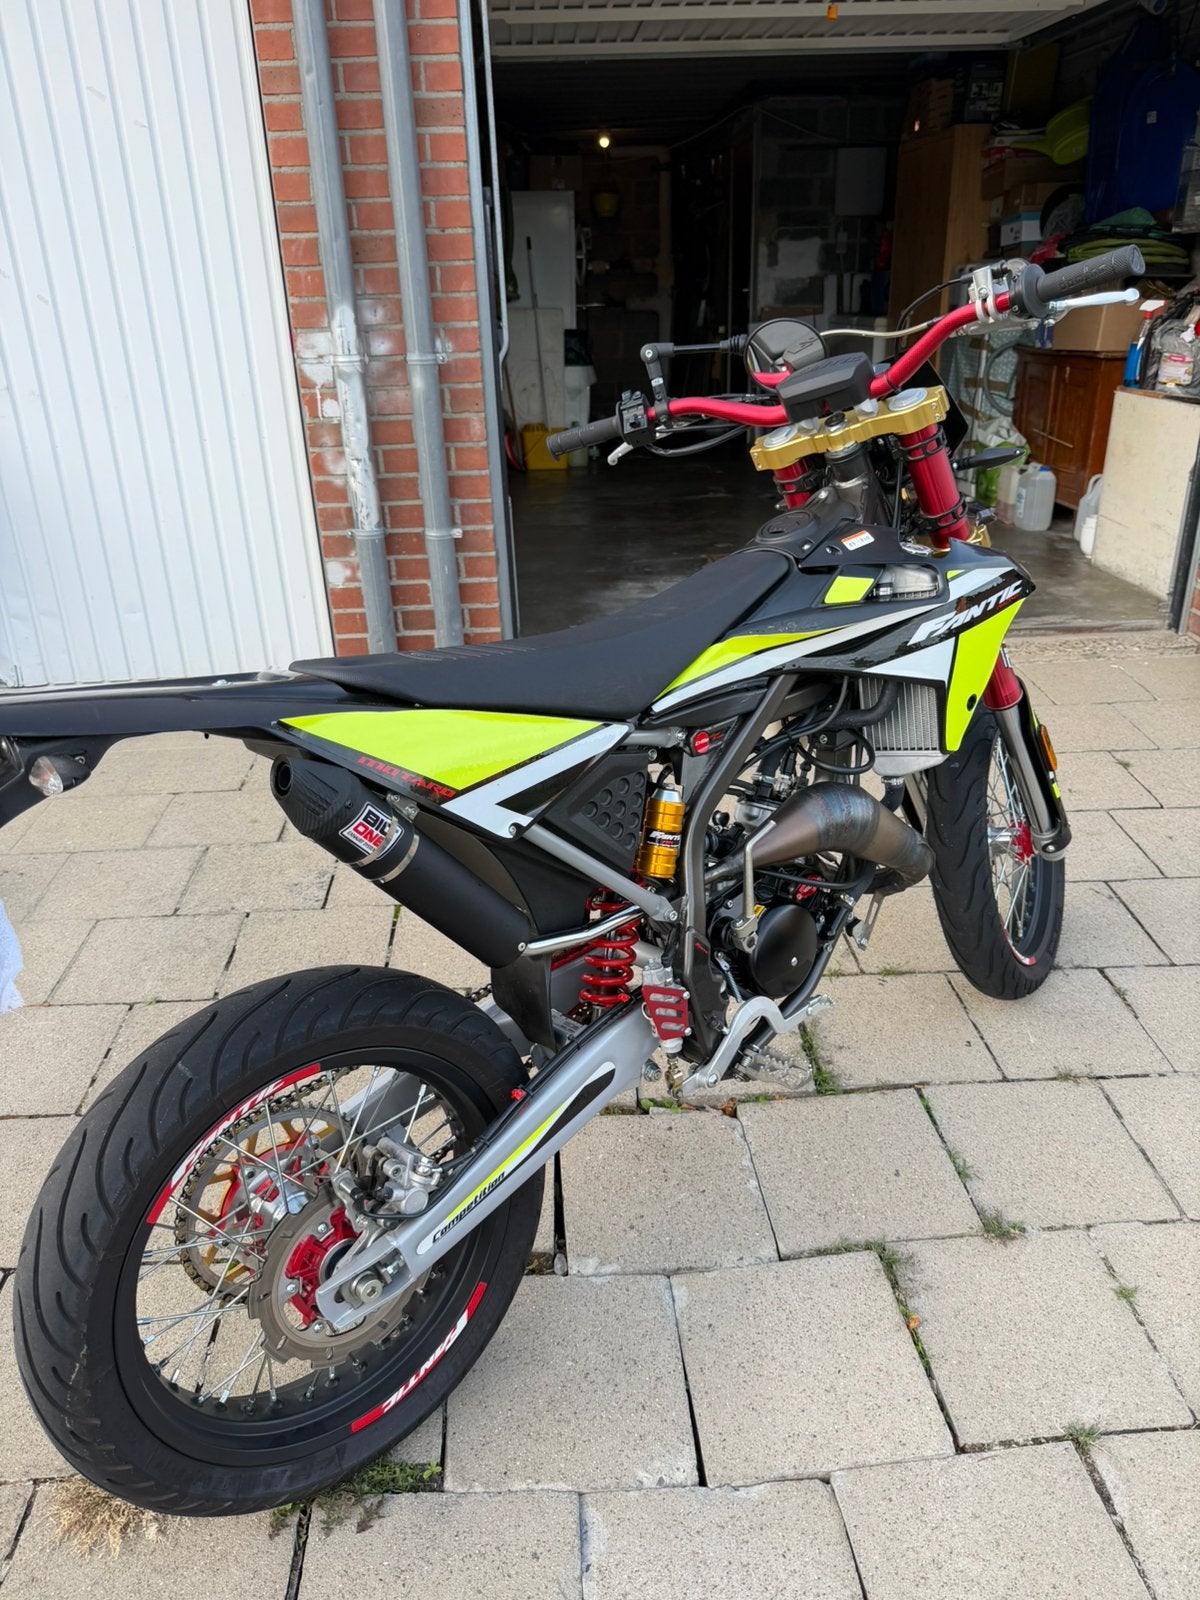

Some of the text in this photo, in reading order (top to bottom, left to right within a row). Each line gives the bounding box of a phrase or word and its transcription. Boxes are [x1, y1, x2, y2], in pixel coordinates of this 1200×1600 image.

[907, 579, 1023, 647] FANTIC
[357, 756, 456, 799] MOTARD
[352, 821, 385, 848] ONE
[171, 1079, 286, 1188] FANTIC
[431, 1171, 506, 1244] Competition
[382, 1309, 470, 1414] FANTIC
